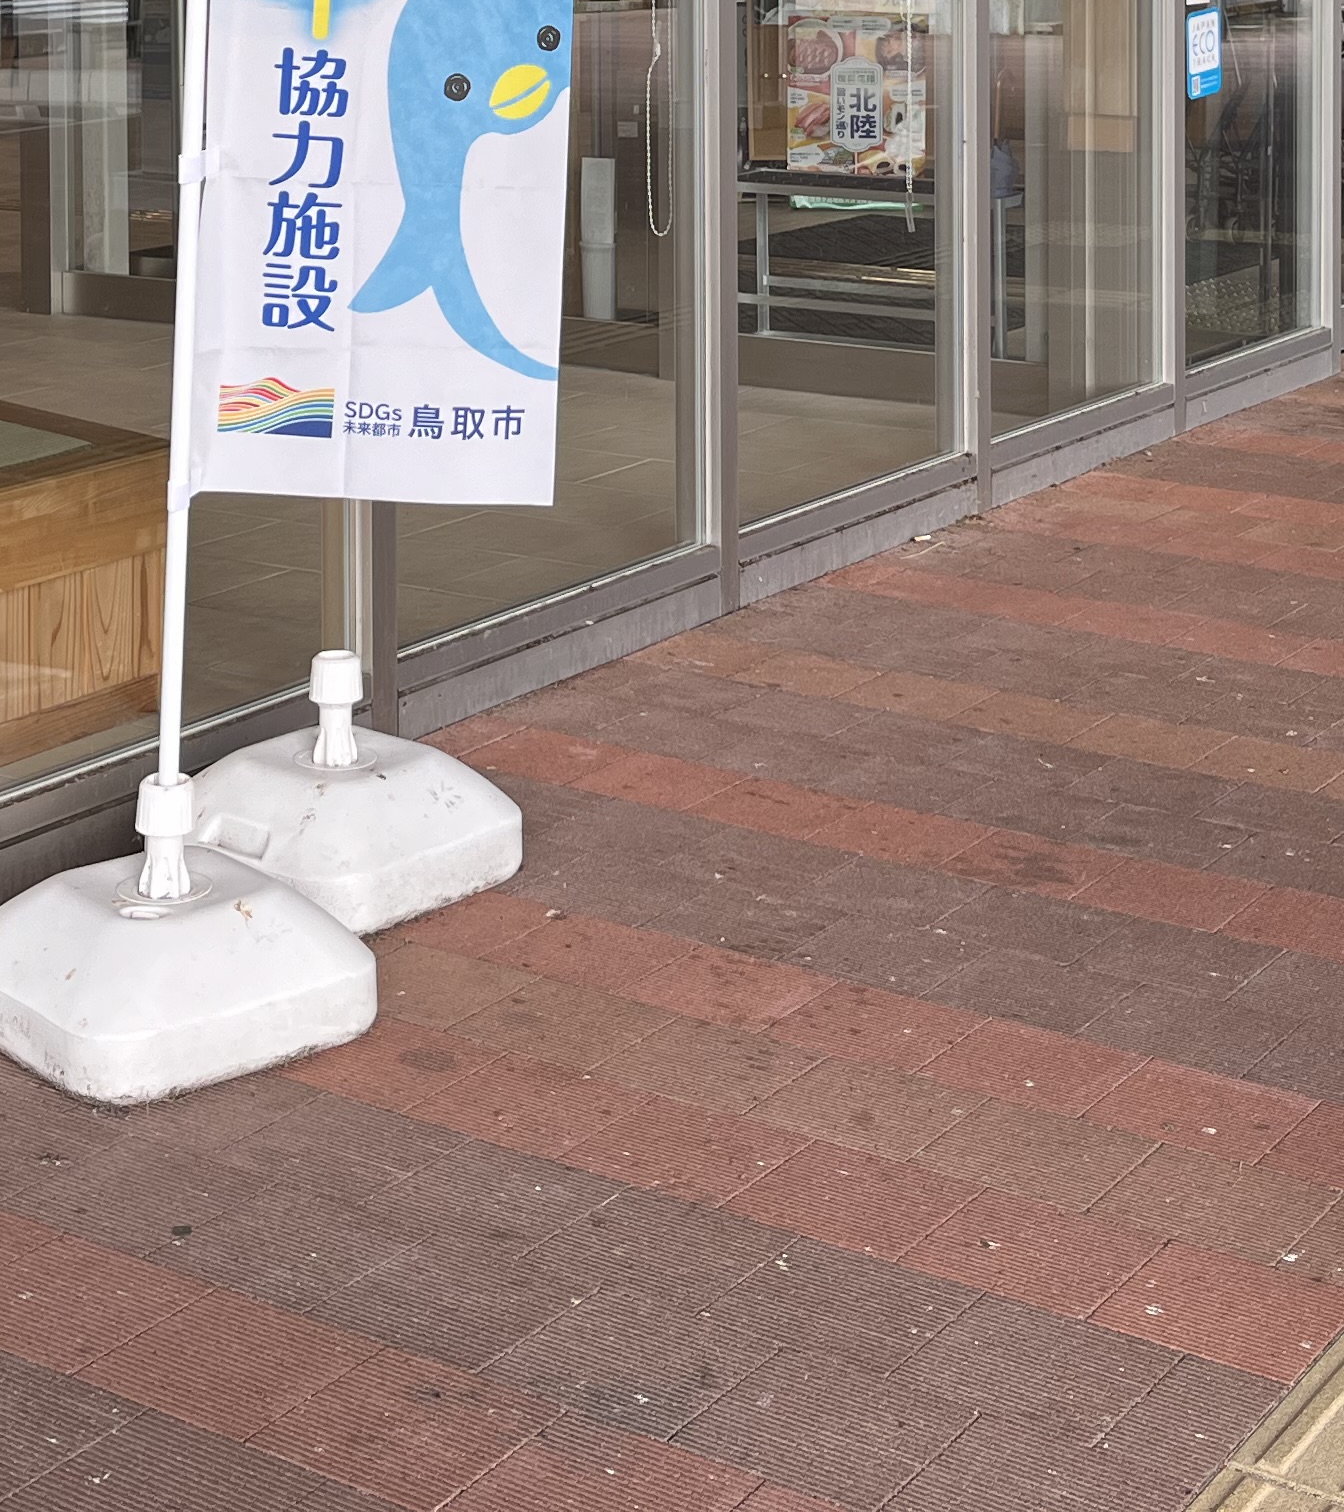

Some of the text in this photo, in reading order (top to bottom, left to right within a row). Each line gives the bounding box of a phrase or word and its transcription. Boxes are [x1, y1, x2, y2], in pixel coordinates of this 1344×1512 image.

[849, 87, 878, 140] 北陸
[262, 46, 349, 332] 協力施設
[342, 419, 402, 438] 未来都市
[343, 401, 403, 422] SDGs
[407, 403, 526, 441] 鳥取市
